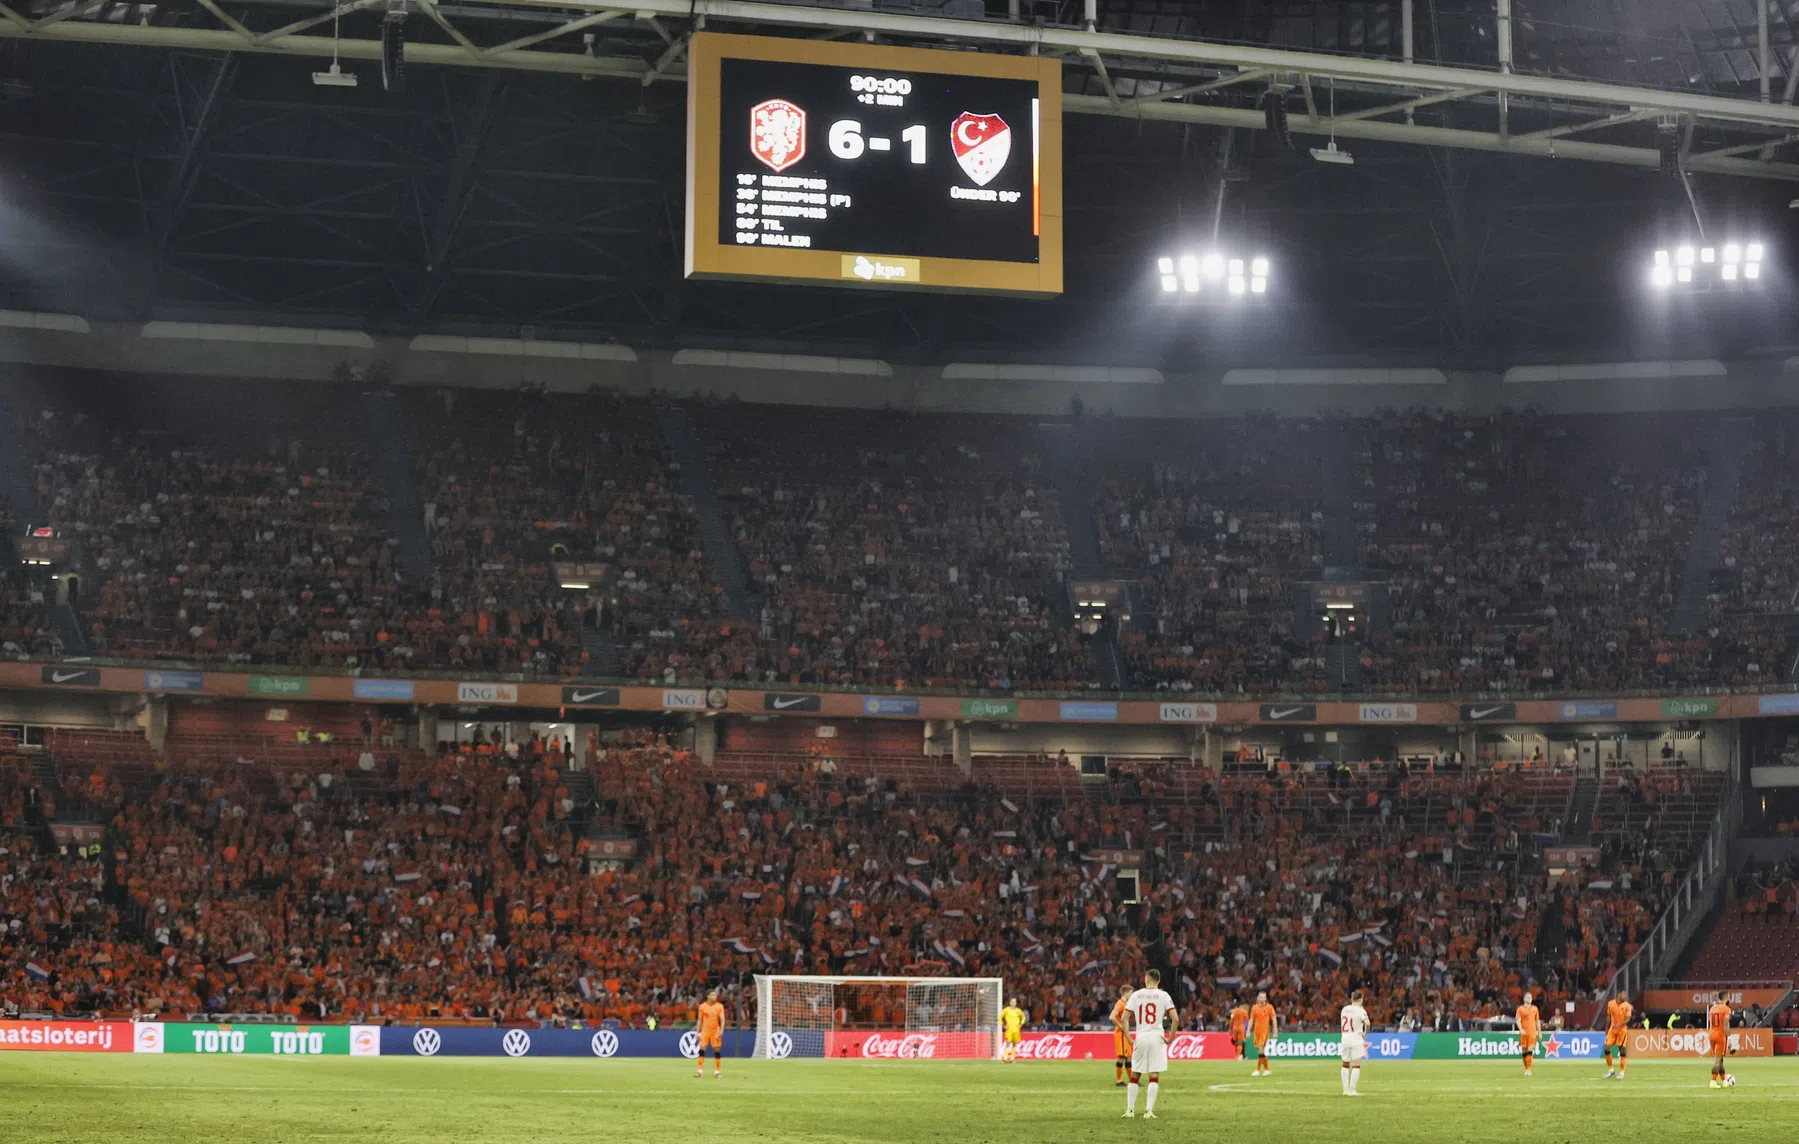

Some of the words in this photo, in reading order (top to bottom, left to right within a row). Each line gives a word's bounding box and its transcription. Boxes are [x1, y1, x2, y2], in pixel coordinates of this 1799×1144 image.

[850, 75, 912, 95] 90:00
[829, 119, 865, 159] 6
[869, 137, 891, 151] -
[902, 124, 927, 164] 1
[761, 175, 828, 190] MEMPHIS
[761, 189, 828, 205] MEMPHIS
[761, 204, 828, 220] MEMPHIS
[761, 233, 811, 248] MALEN
[875, 262, 906, 280] kpn
[462, 687, 492, 700] ING
[667, 694, 697, 706] ING
[985, 703, 1008, 716] kpn
[1164, 707, 1192, 719] ING
[1363, 707, 1392, 720] ING
[1684, 701, 1708, 713] kpn
[1138, 1002, 1157, 1025] 18
[1341, 1016, 1355, 1033] 21
[192, 1029, 246, 1054] TOTO
[270, 1031, 324, 1055] TOTO
[862, 1034, 938, 1058] Coca-Cola
